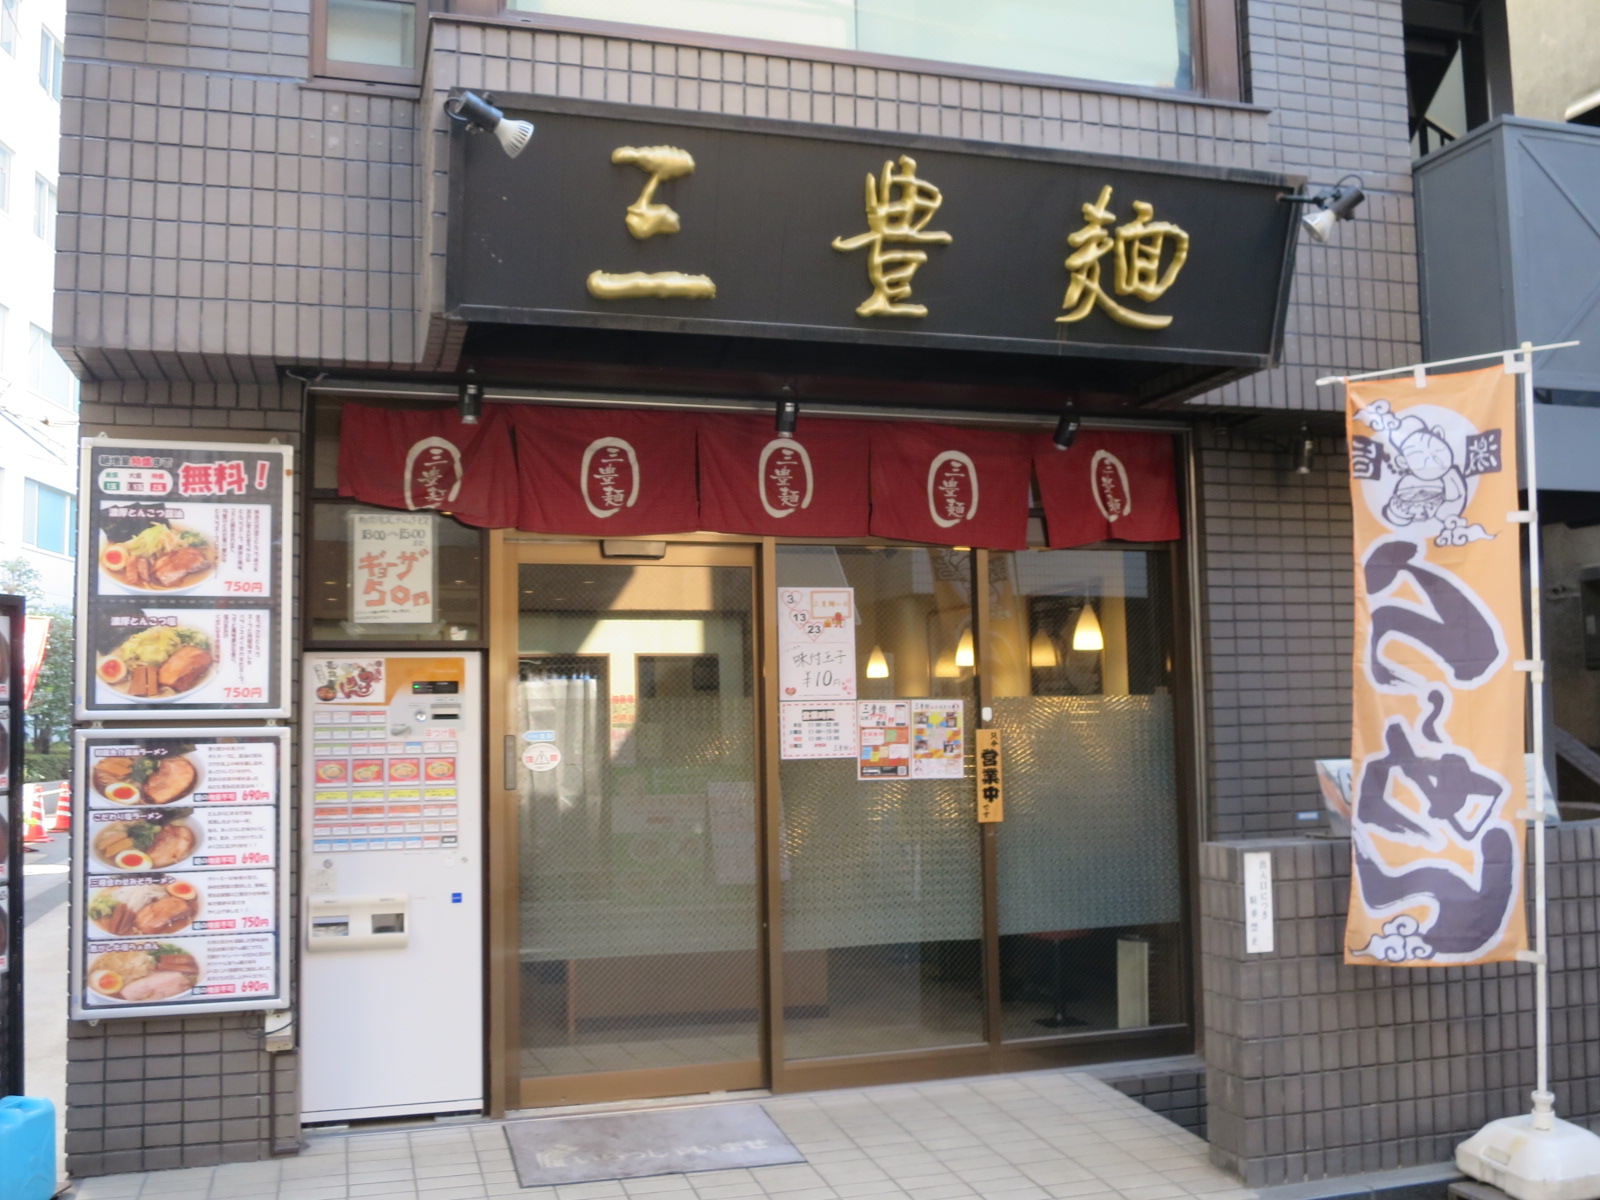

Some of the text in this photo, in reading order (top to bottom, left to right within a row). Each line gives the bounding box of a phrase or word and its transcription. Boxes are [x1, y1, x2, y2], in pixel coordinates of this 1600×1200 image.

[593, 447, 625, 508] 三豊麺
[770, 448, 799, 507] 三豊麺
[938, 460, 966, 519] 三豊麺
[358, 548, 430, 581] ギョーザ
[224, 580, 263, 593] 750円
[363, 578, 431, 607] 50円
[793, 613, 807, 622] 13
[807, 625, 822, 634] 23
[223, 686, 262, 699] 750円
[981, 748, 1001, 803] 営業中
[241, 790, 270, 801] 690円
[241, 853, 270, 865] 690円
[241, 916, 269, 930] 750円
[241, 981, 269, 994] 690円
